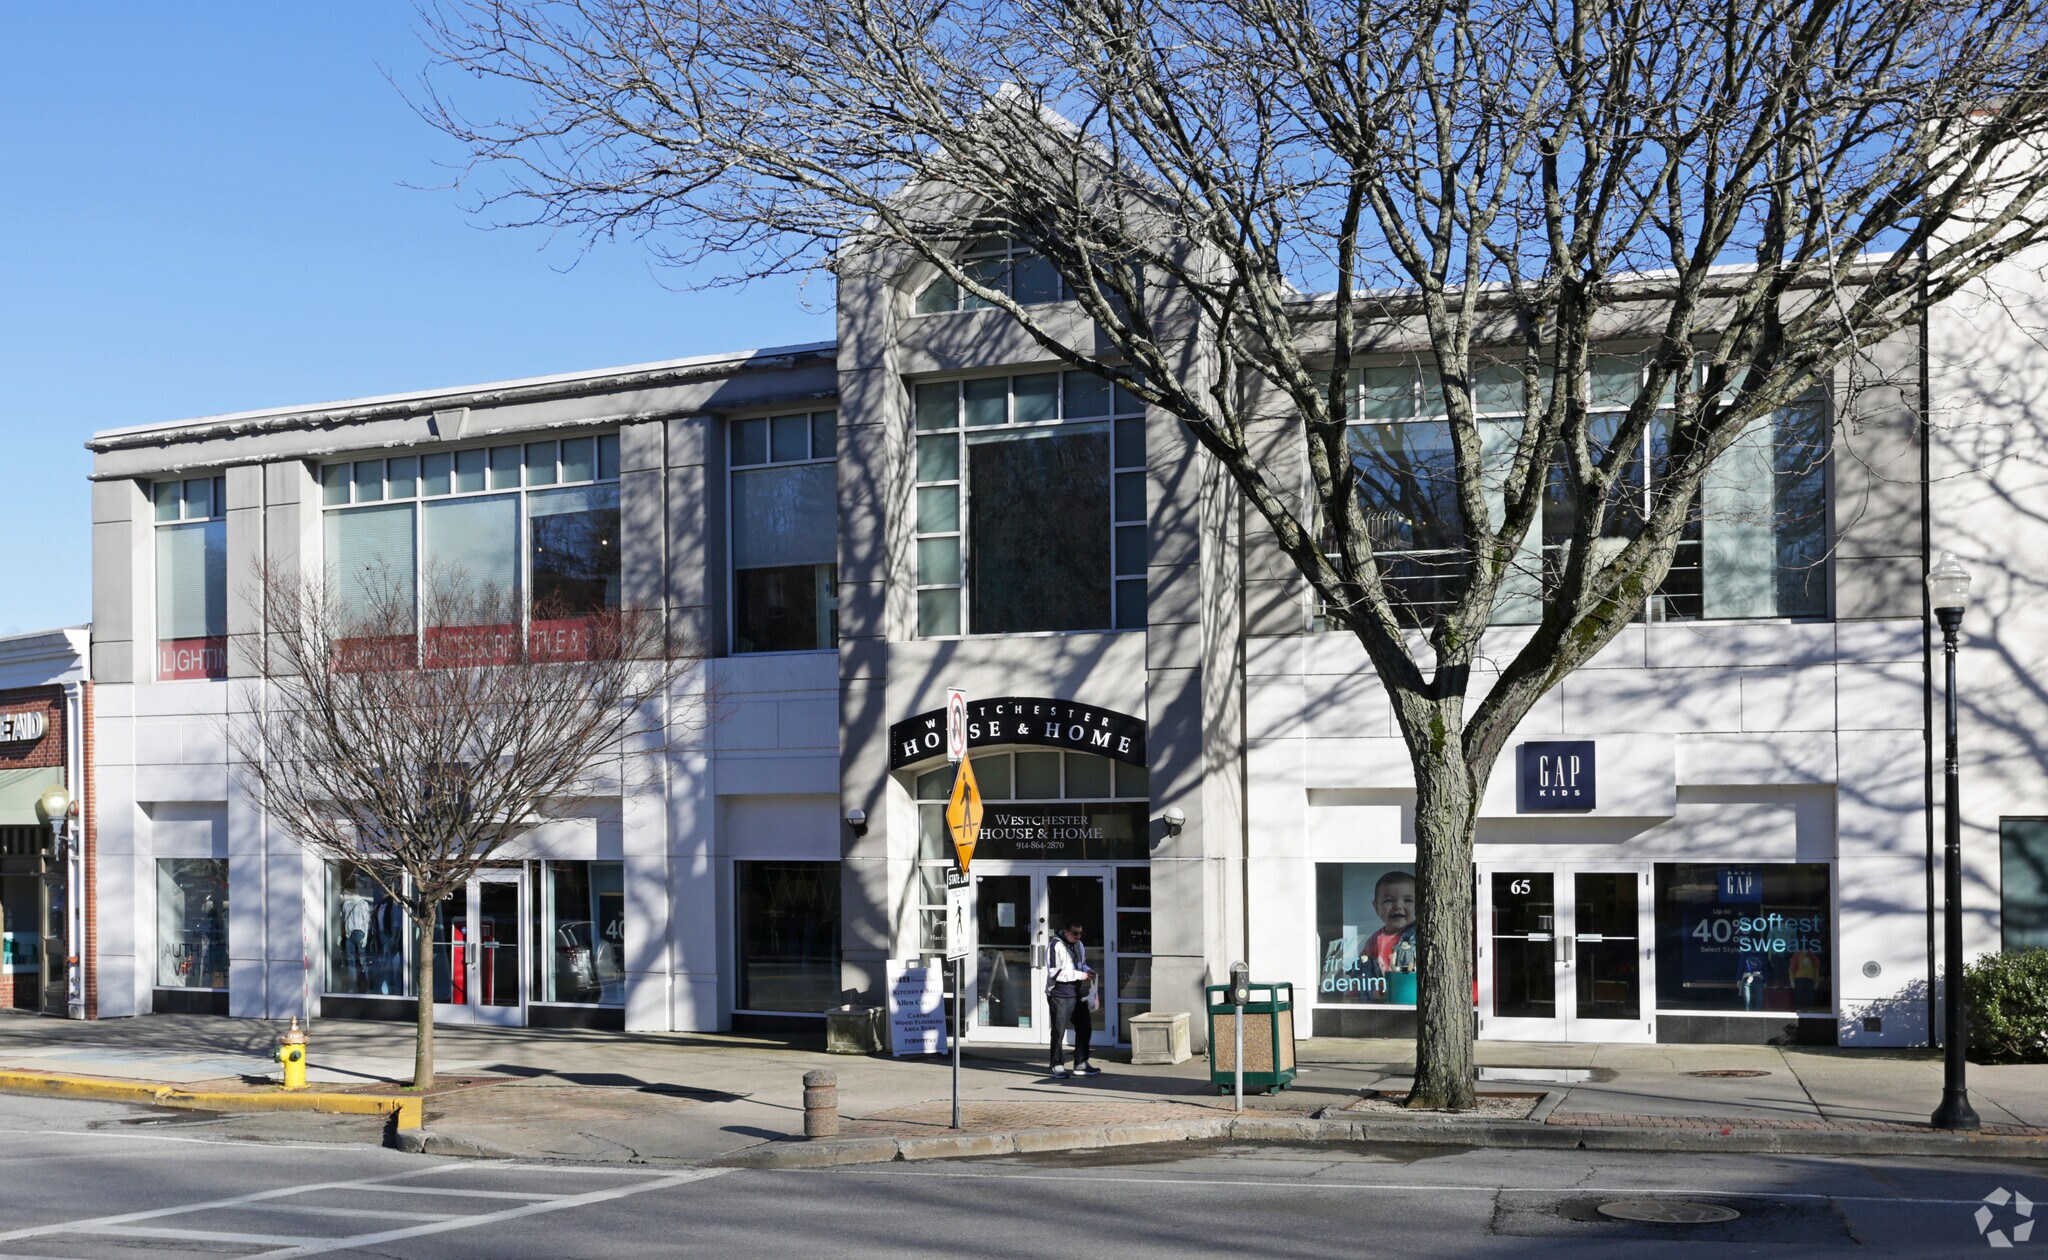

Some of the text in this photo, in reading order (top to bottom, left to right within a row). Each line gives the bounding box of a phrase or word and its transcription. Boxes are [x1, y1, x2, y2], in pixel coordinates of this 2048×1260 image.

[903, 721, 1001, 757] HOSE
[1017, 722, 1029, 735] &
[1044, 721, 1132, 754] HOME
[1540, 755, 1580, 787] GAP
[1540, 789, 1581, 797] KIDS
[979, 828, 1103, 840] HOUSE & HOME
[1510, 879, 1531, 895] 65
[1727, 876, 1752, 895] GAP
[1739, 912, 1821, 933] softest
[1739, 935, 1822, 953] sweats
[1325, 955, 1360, 972] first
[1322, 973, 1387, 992] denim
